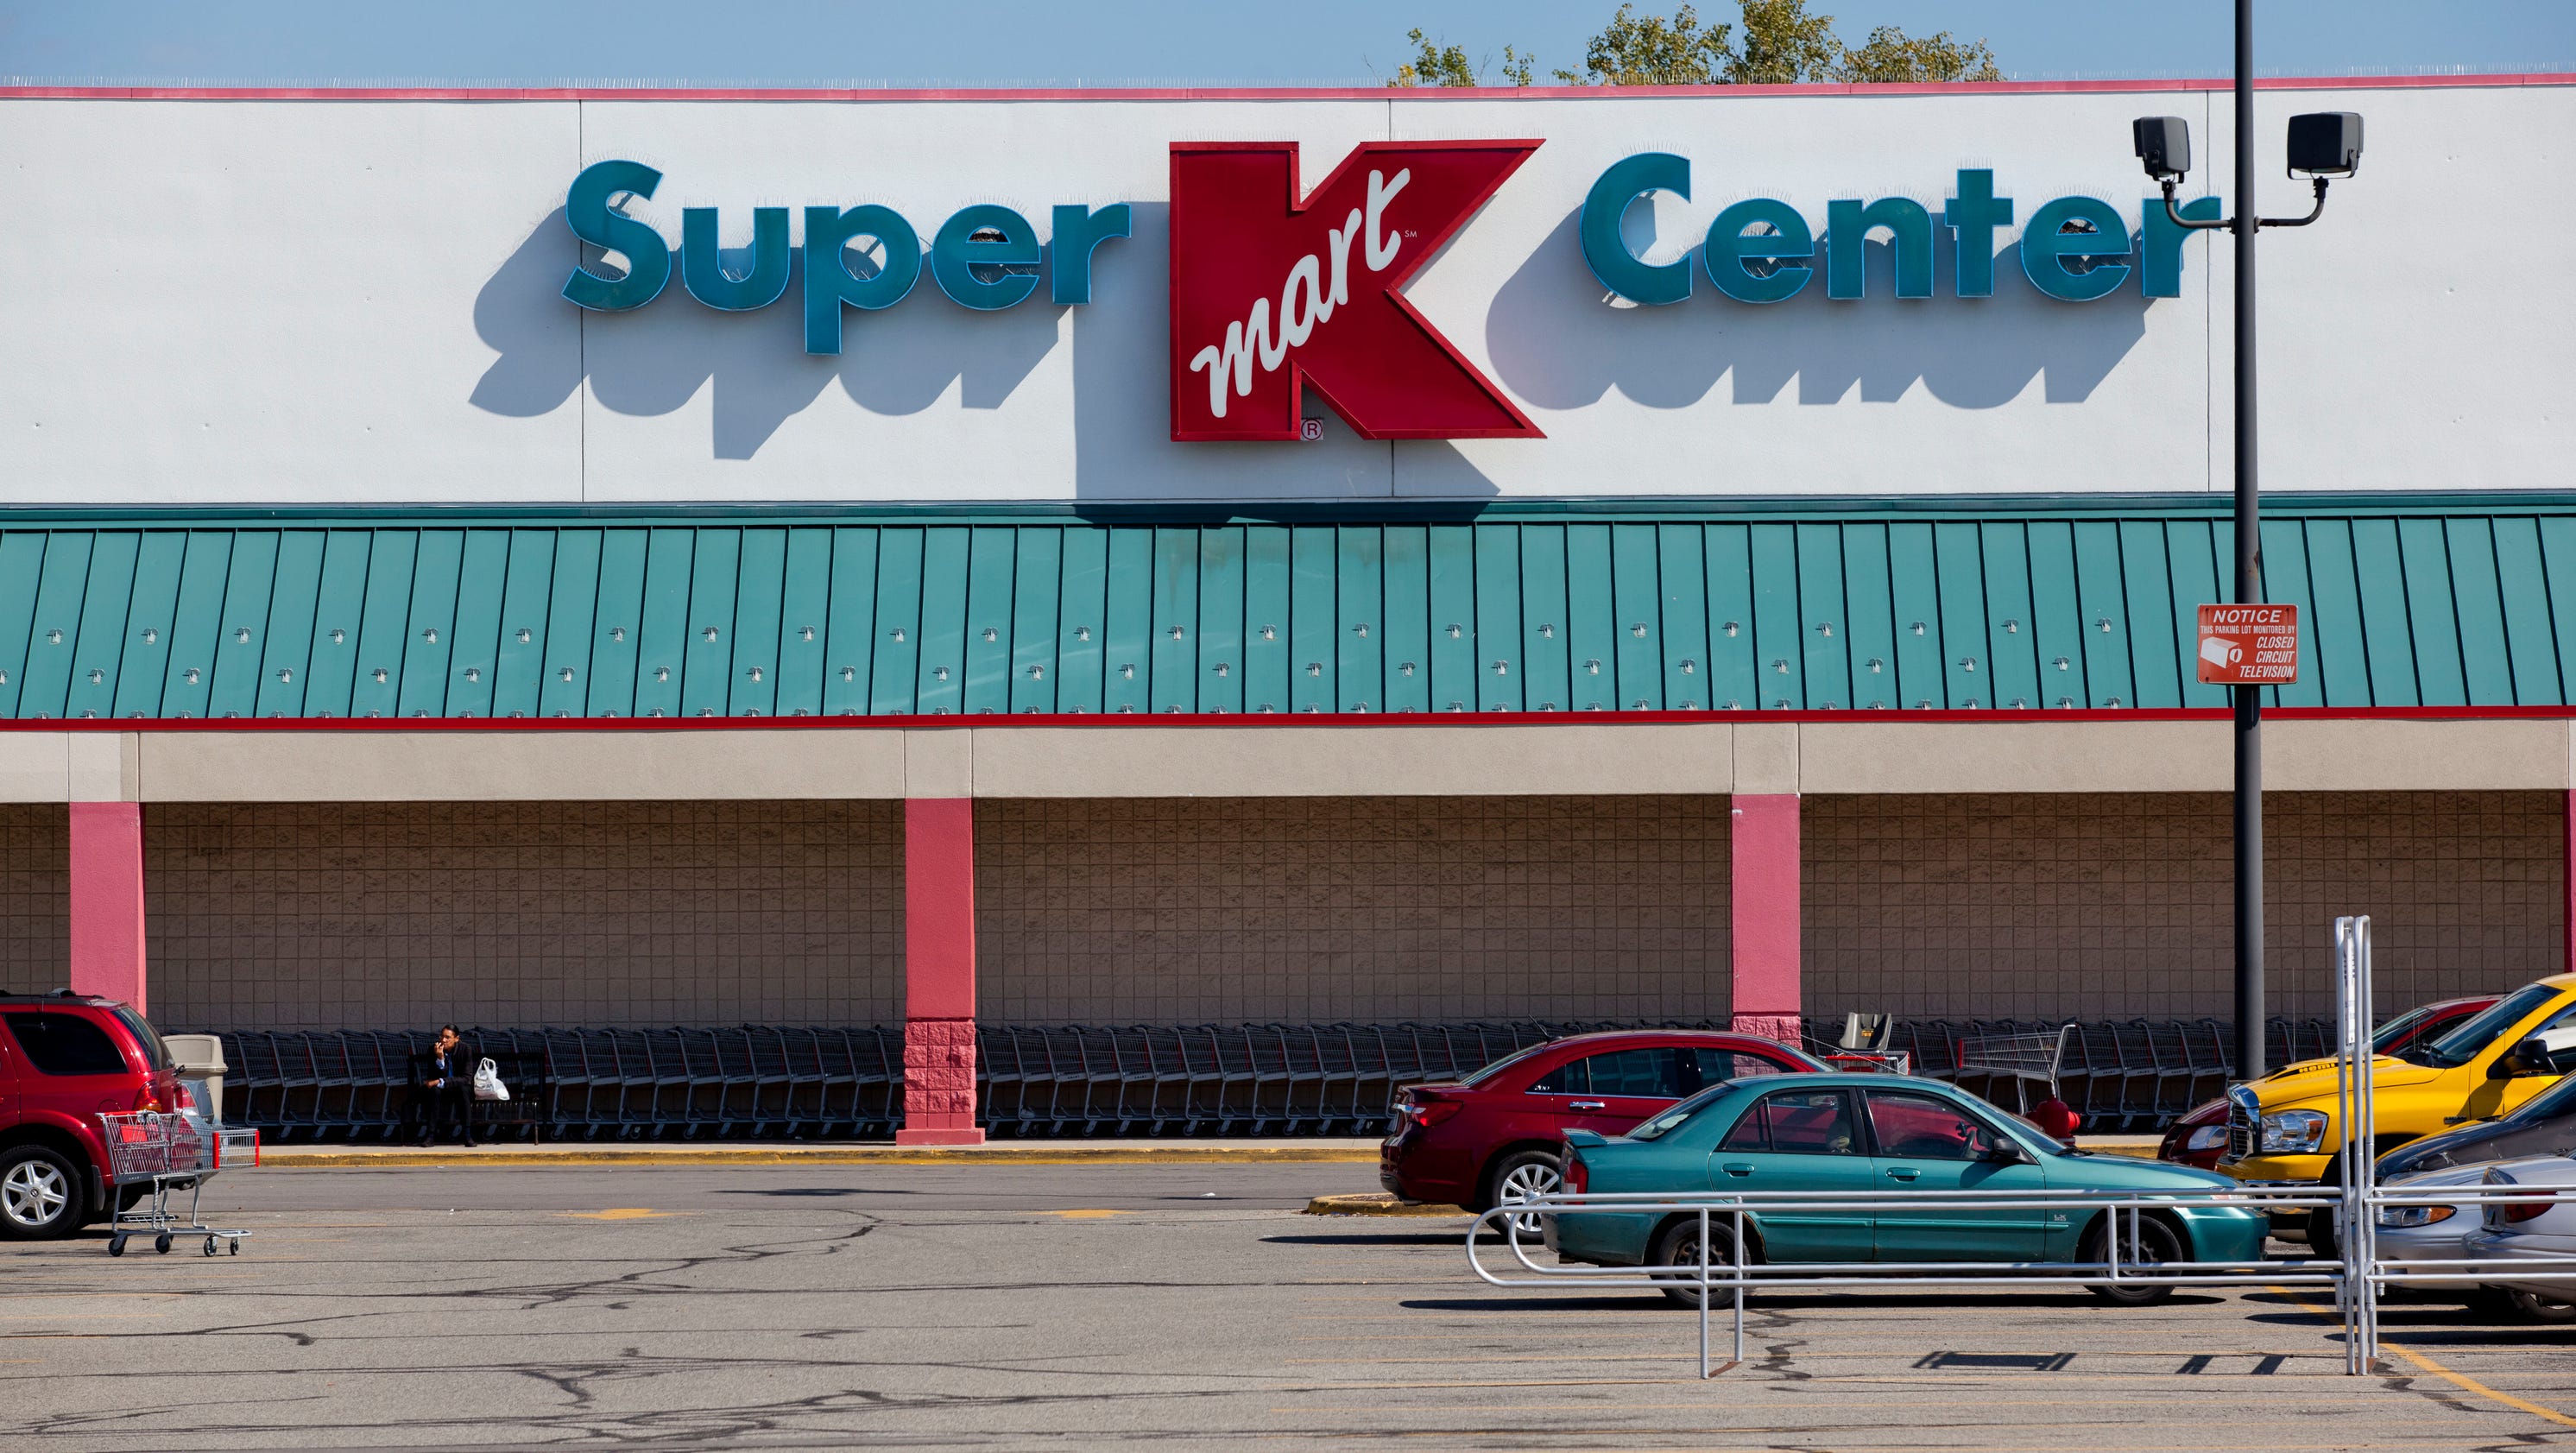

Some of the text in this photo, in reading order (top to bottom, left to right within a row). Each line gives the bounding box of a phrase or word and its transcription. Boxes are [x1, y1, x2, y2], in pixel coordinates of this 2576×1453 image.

[1579, 151, 2222, 306] Center
[560, 159, 1132, 357] Super
[1190, 167, 1411, 418] mart
[2213, 610, 2282, 622] NOTICE
[2200, 625, 2295, 634] THIS PARKING LOT MONITORED BY
[2256, 636, 2295, 648] CLOSED
[2256, 651, 2295, 663] CIRCUIT
[2239, 666, 2295, 678] TELEVISION
